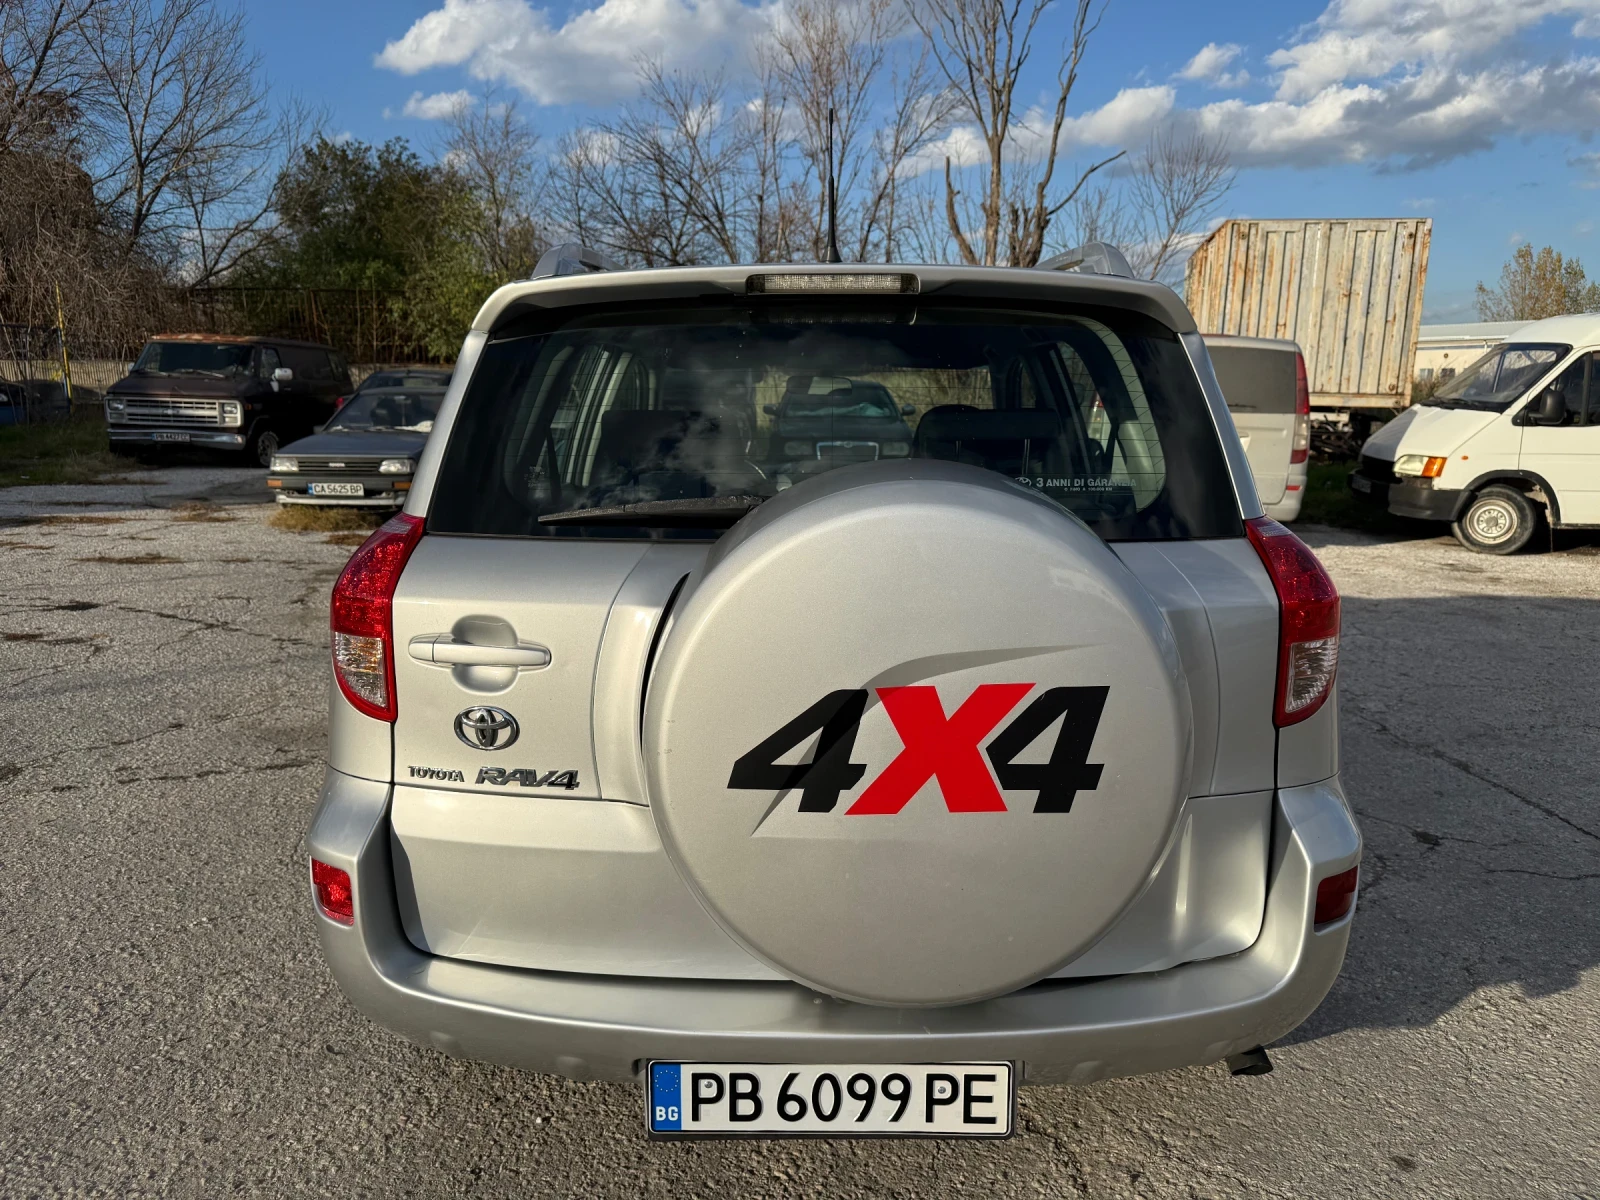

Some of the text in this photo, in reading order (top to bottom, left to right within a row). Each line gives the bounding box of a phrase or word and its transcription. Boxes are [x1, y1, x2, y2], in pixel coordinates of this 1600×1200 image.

[313, 484, 362, 494] CA 5625 BP
[1036, 478, 1043, 487] 3
[1046, 479, 1070, 487] ANNI
[1074, 479, 1084, 487] DI
[727, 683, 1111, 815] 4X4
[408, 766, 580, 790] TOYOTA RAV4
[655, 1072, 998, 1124] BG PB 6099 PE
